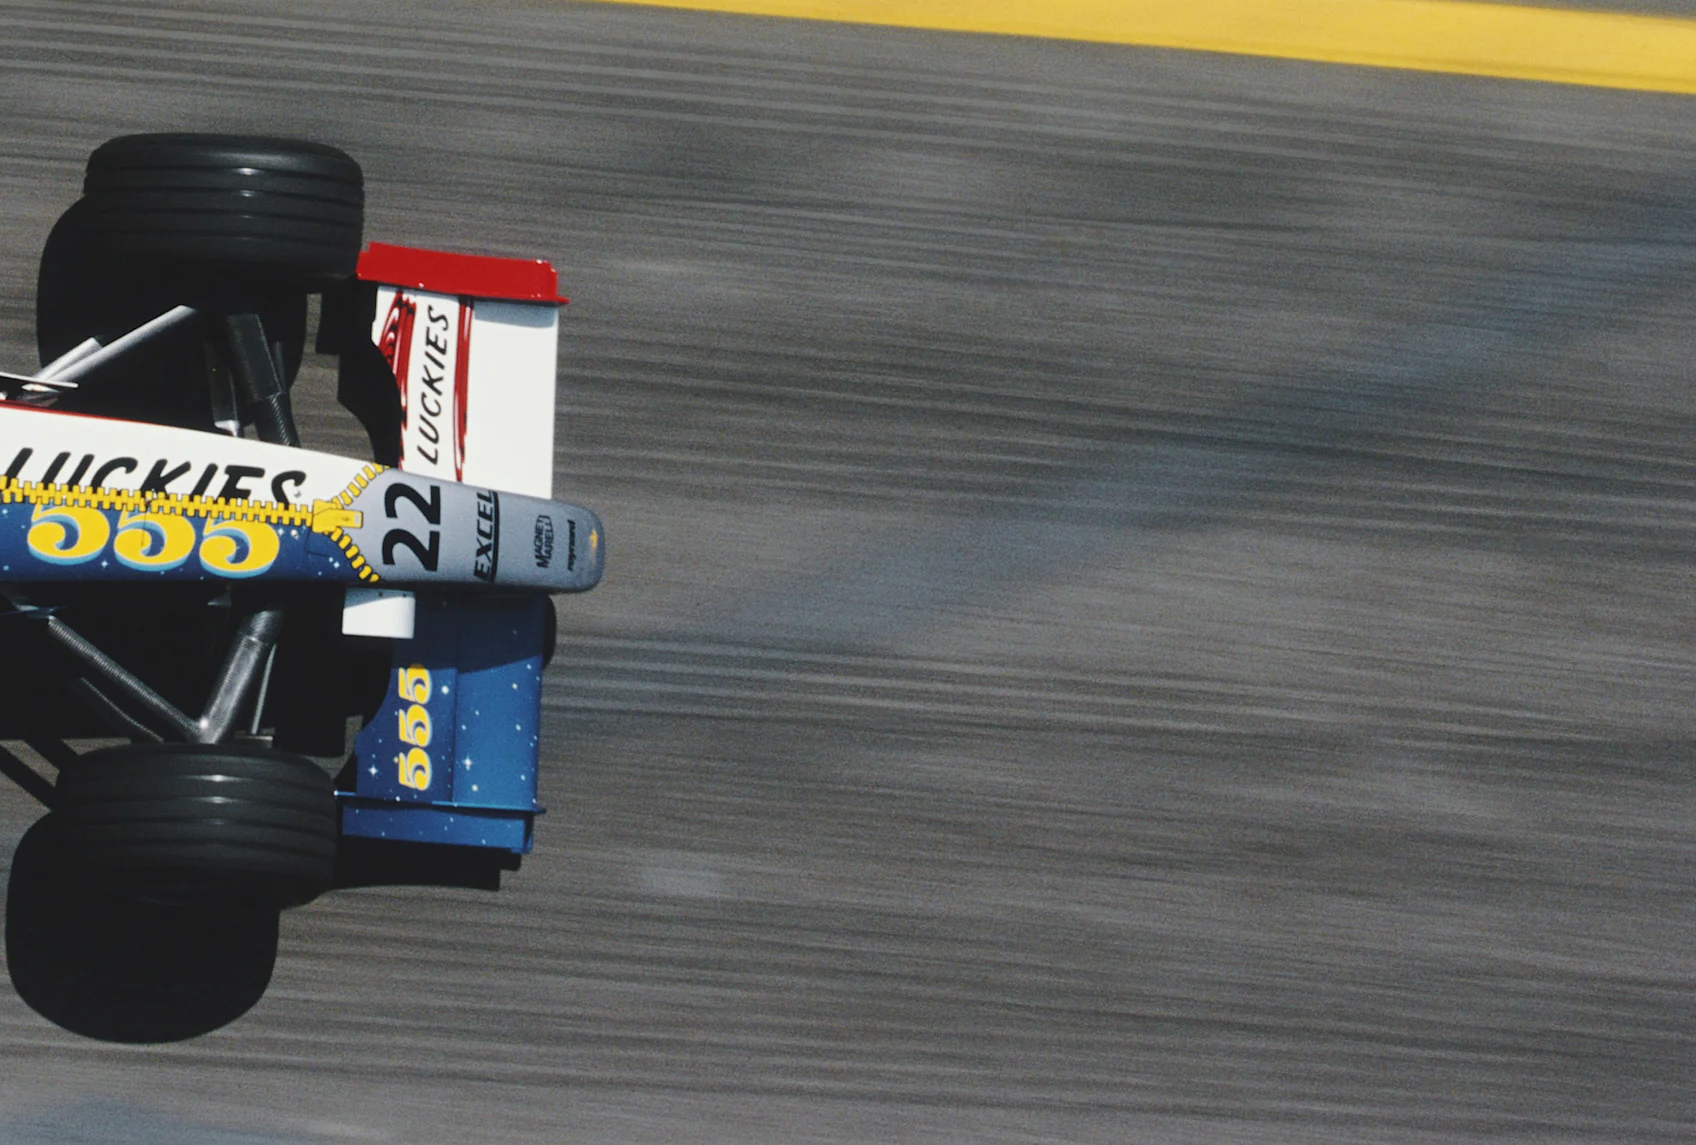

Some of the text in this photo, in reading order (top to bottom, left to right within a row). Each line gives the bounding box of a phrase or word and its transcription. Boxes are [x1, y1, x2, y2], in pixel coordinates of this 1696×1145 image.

[416, 304, 449, 466] LUCKIES
[27, 497, 281, 579] 555
[382, 482, 441, 572] 22
[473, 489, 494, 582] EXCEL
[398, 663, 432, 792] 555
